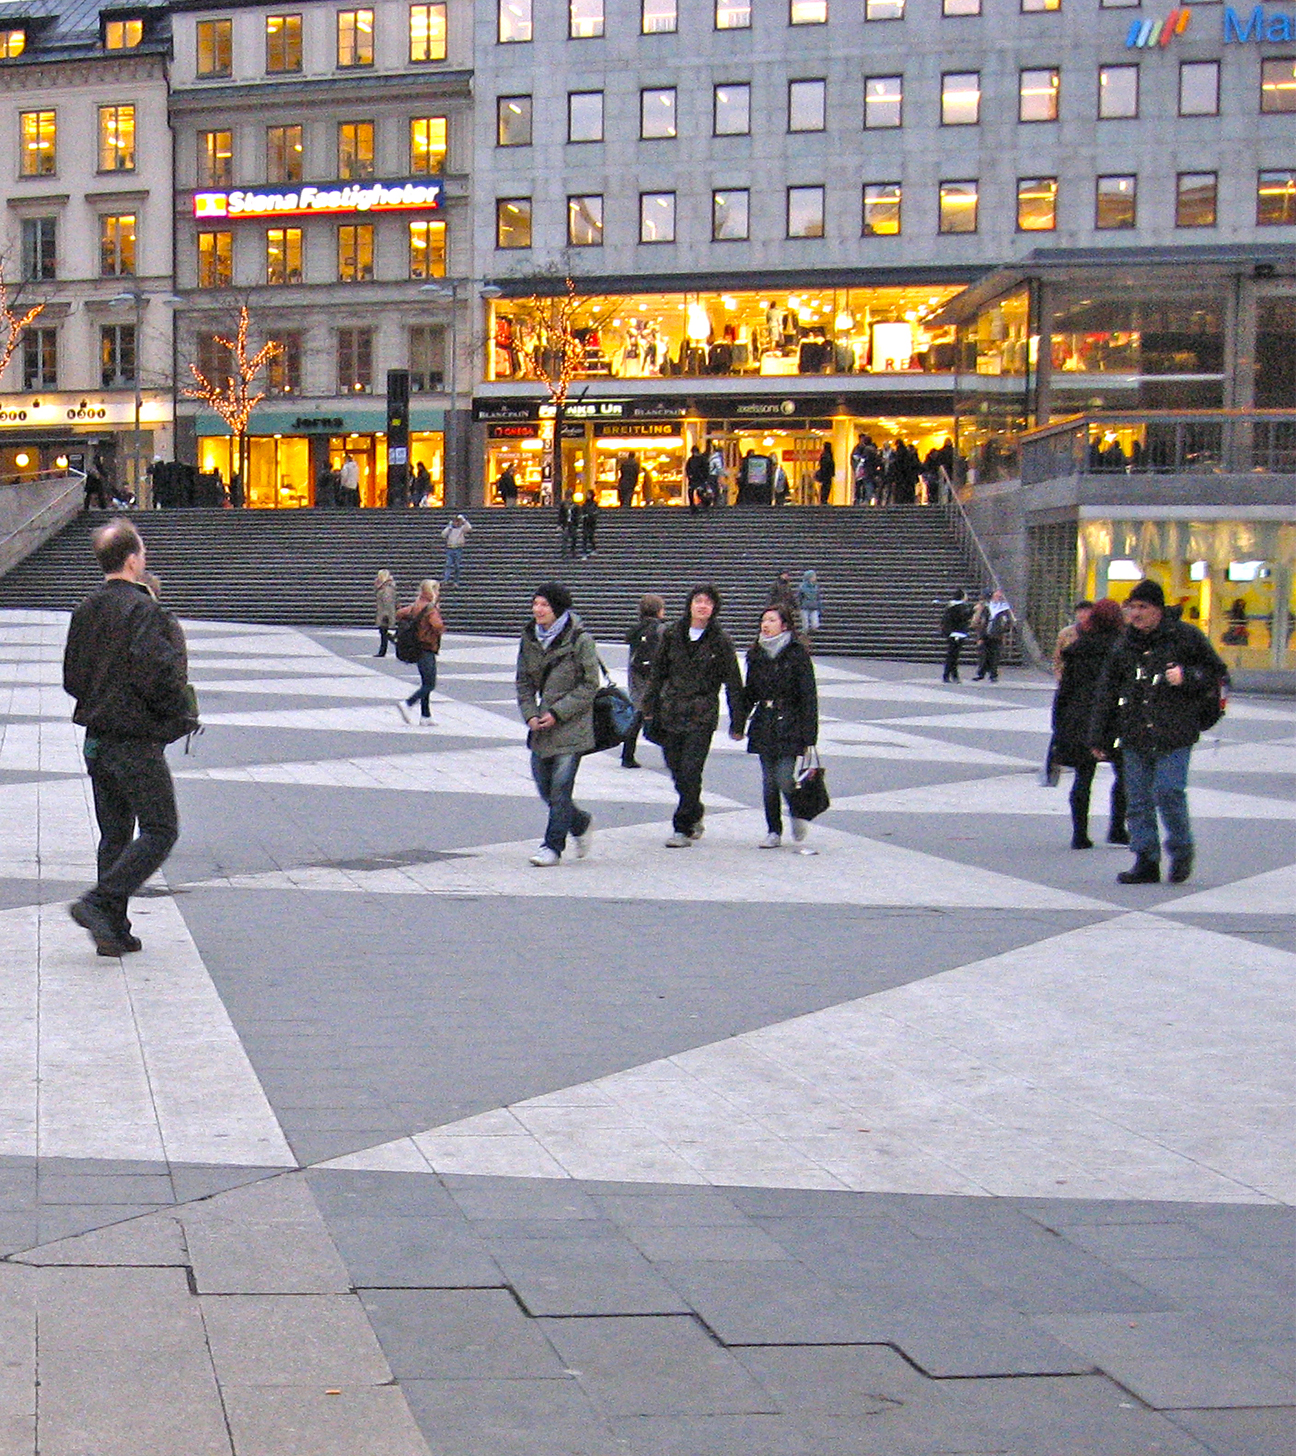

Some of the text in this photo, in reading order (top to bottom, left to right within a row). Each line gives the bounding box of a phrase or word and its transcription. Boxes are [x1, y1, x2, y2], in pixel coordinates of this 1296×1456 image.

[1223, 5, 1296, 44] Ma
[227, 182, 441, 213] Stena Fastigheter
[603, 424, 673, 435] BREITLING
